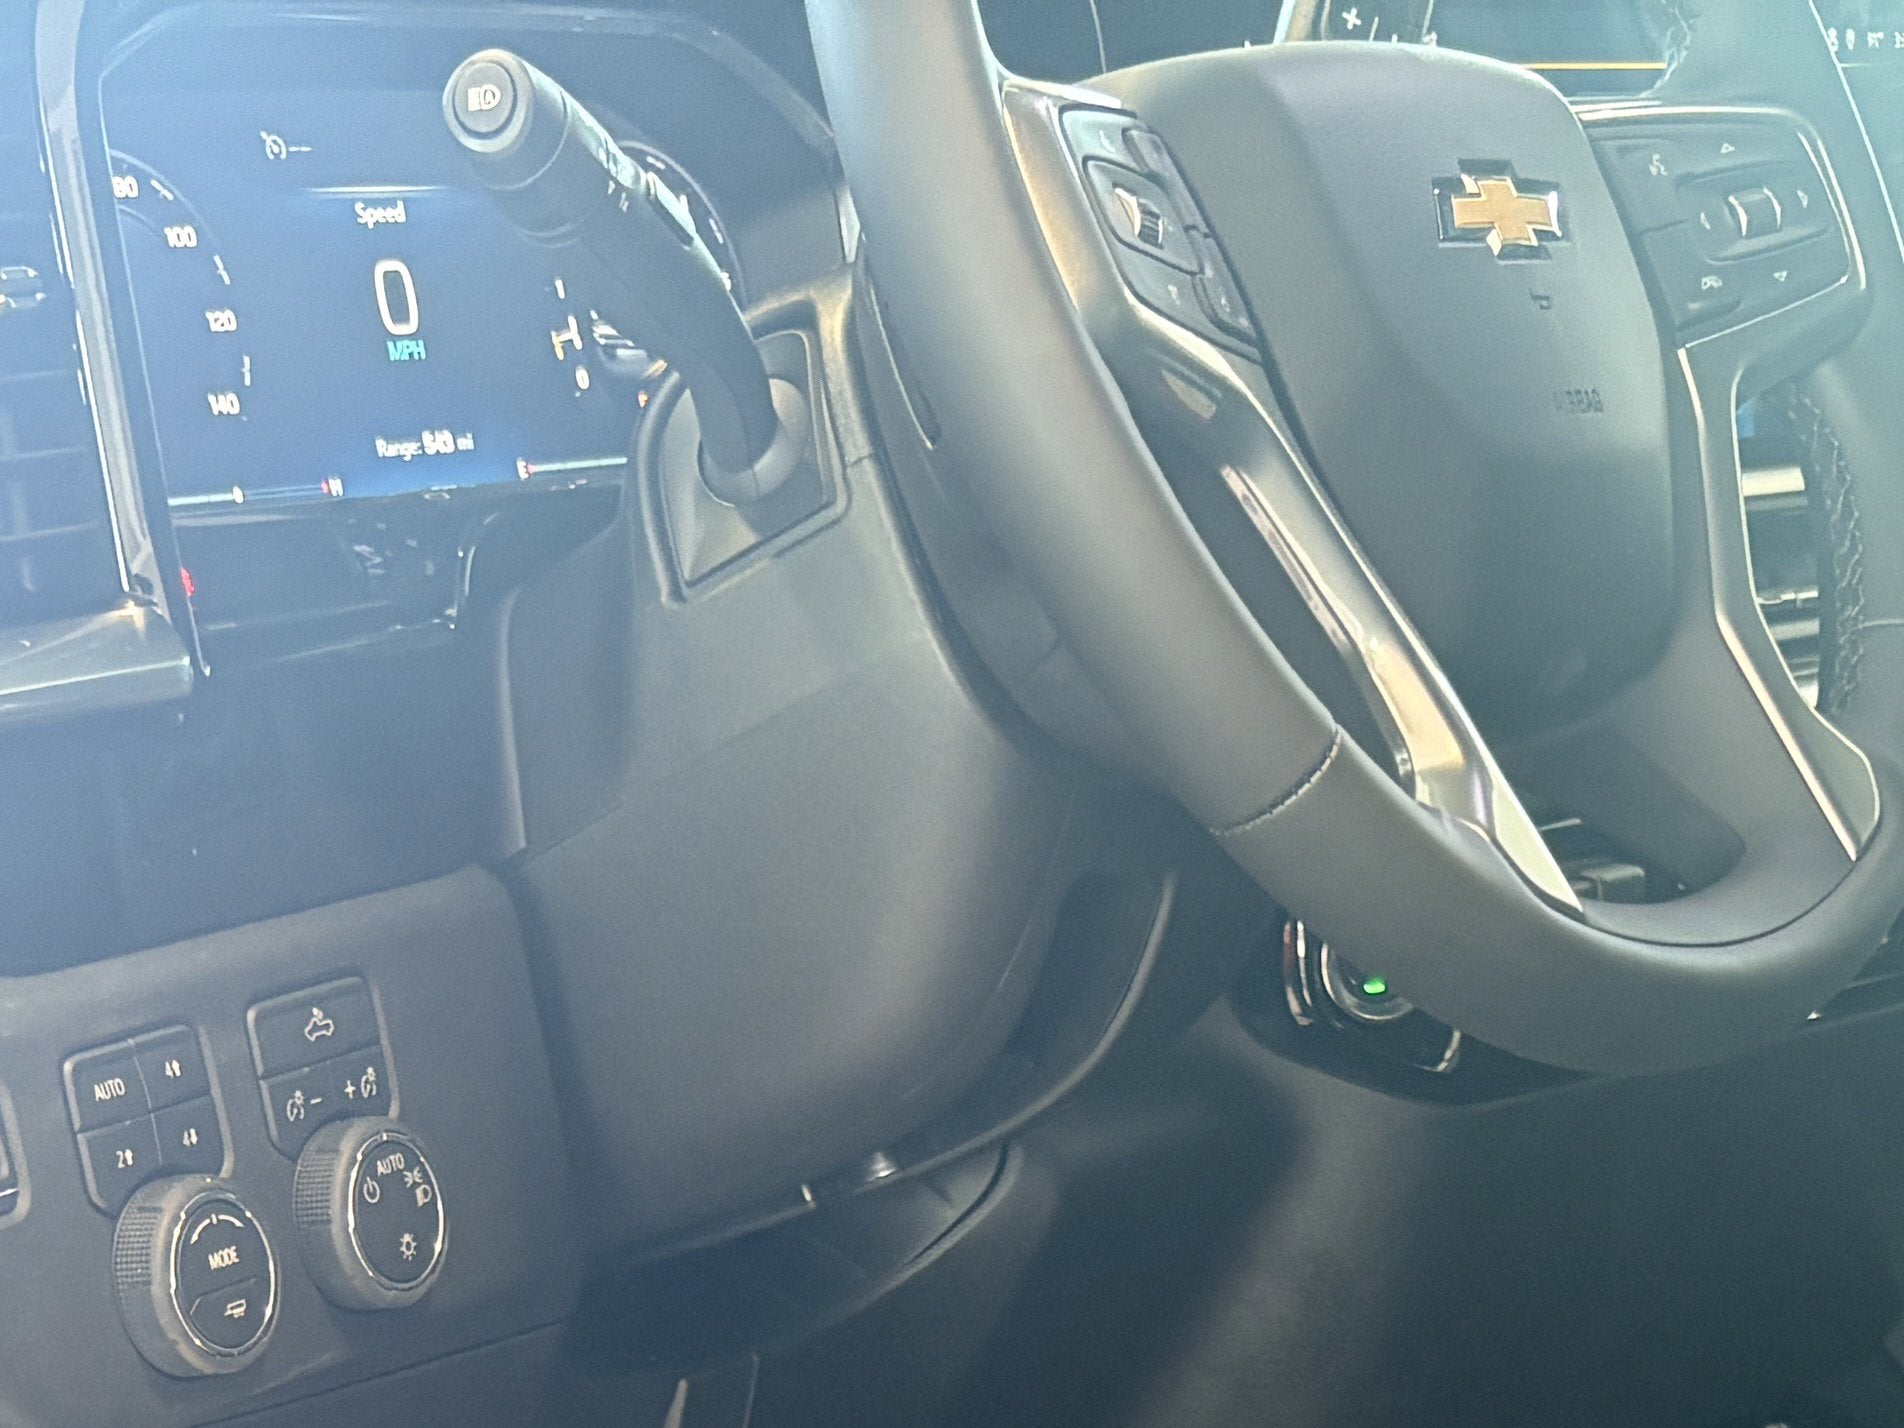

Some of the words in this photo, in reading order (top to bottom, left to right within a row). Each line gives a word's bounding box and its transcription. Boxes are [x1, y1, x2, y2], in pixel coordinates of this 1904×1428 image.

[354, 200, 407, 229] Speed
[163, 225, 198, 248] 100
[373, 258, 419, 336] 0
[204, 309, 238, 332] 120
[386, 339, 427, 362] MPH
[207, 391, 241, 416] 140
[94, 1077, 126, 1102] AUTO
[376, 1152, 405, 1177] AUTO
[208, 1245, 240, 1270] MODE
